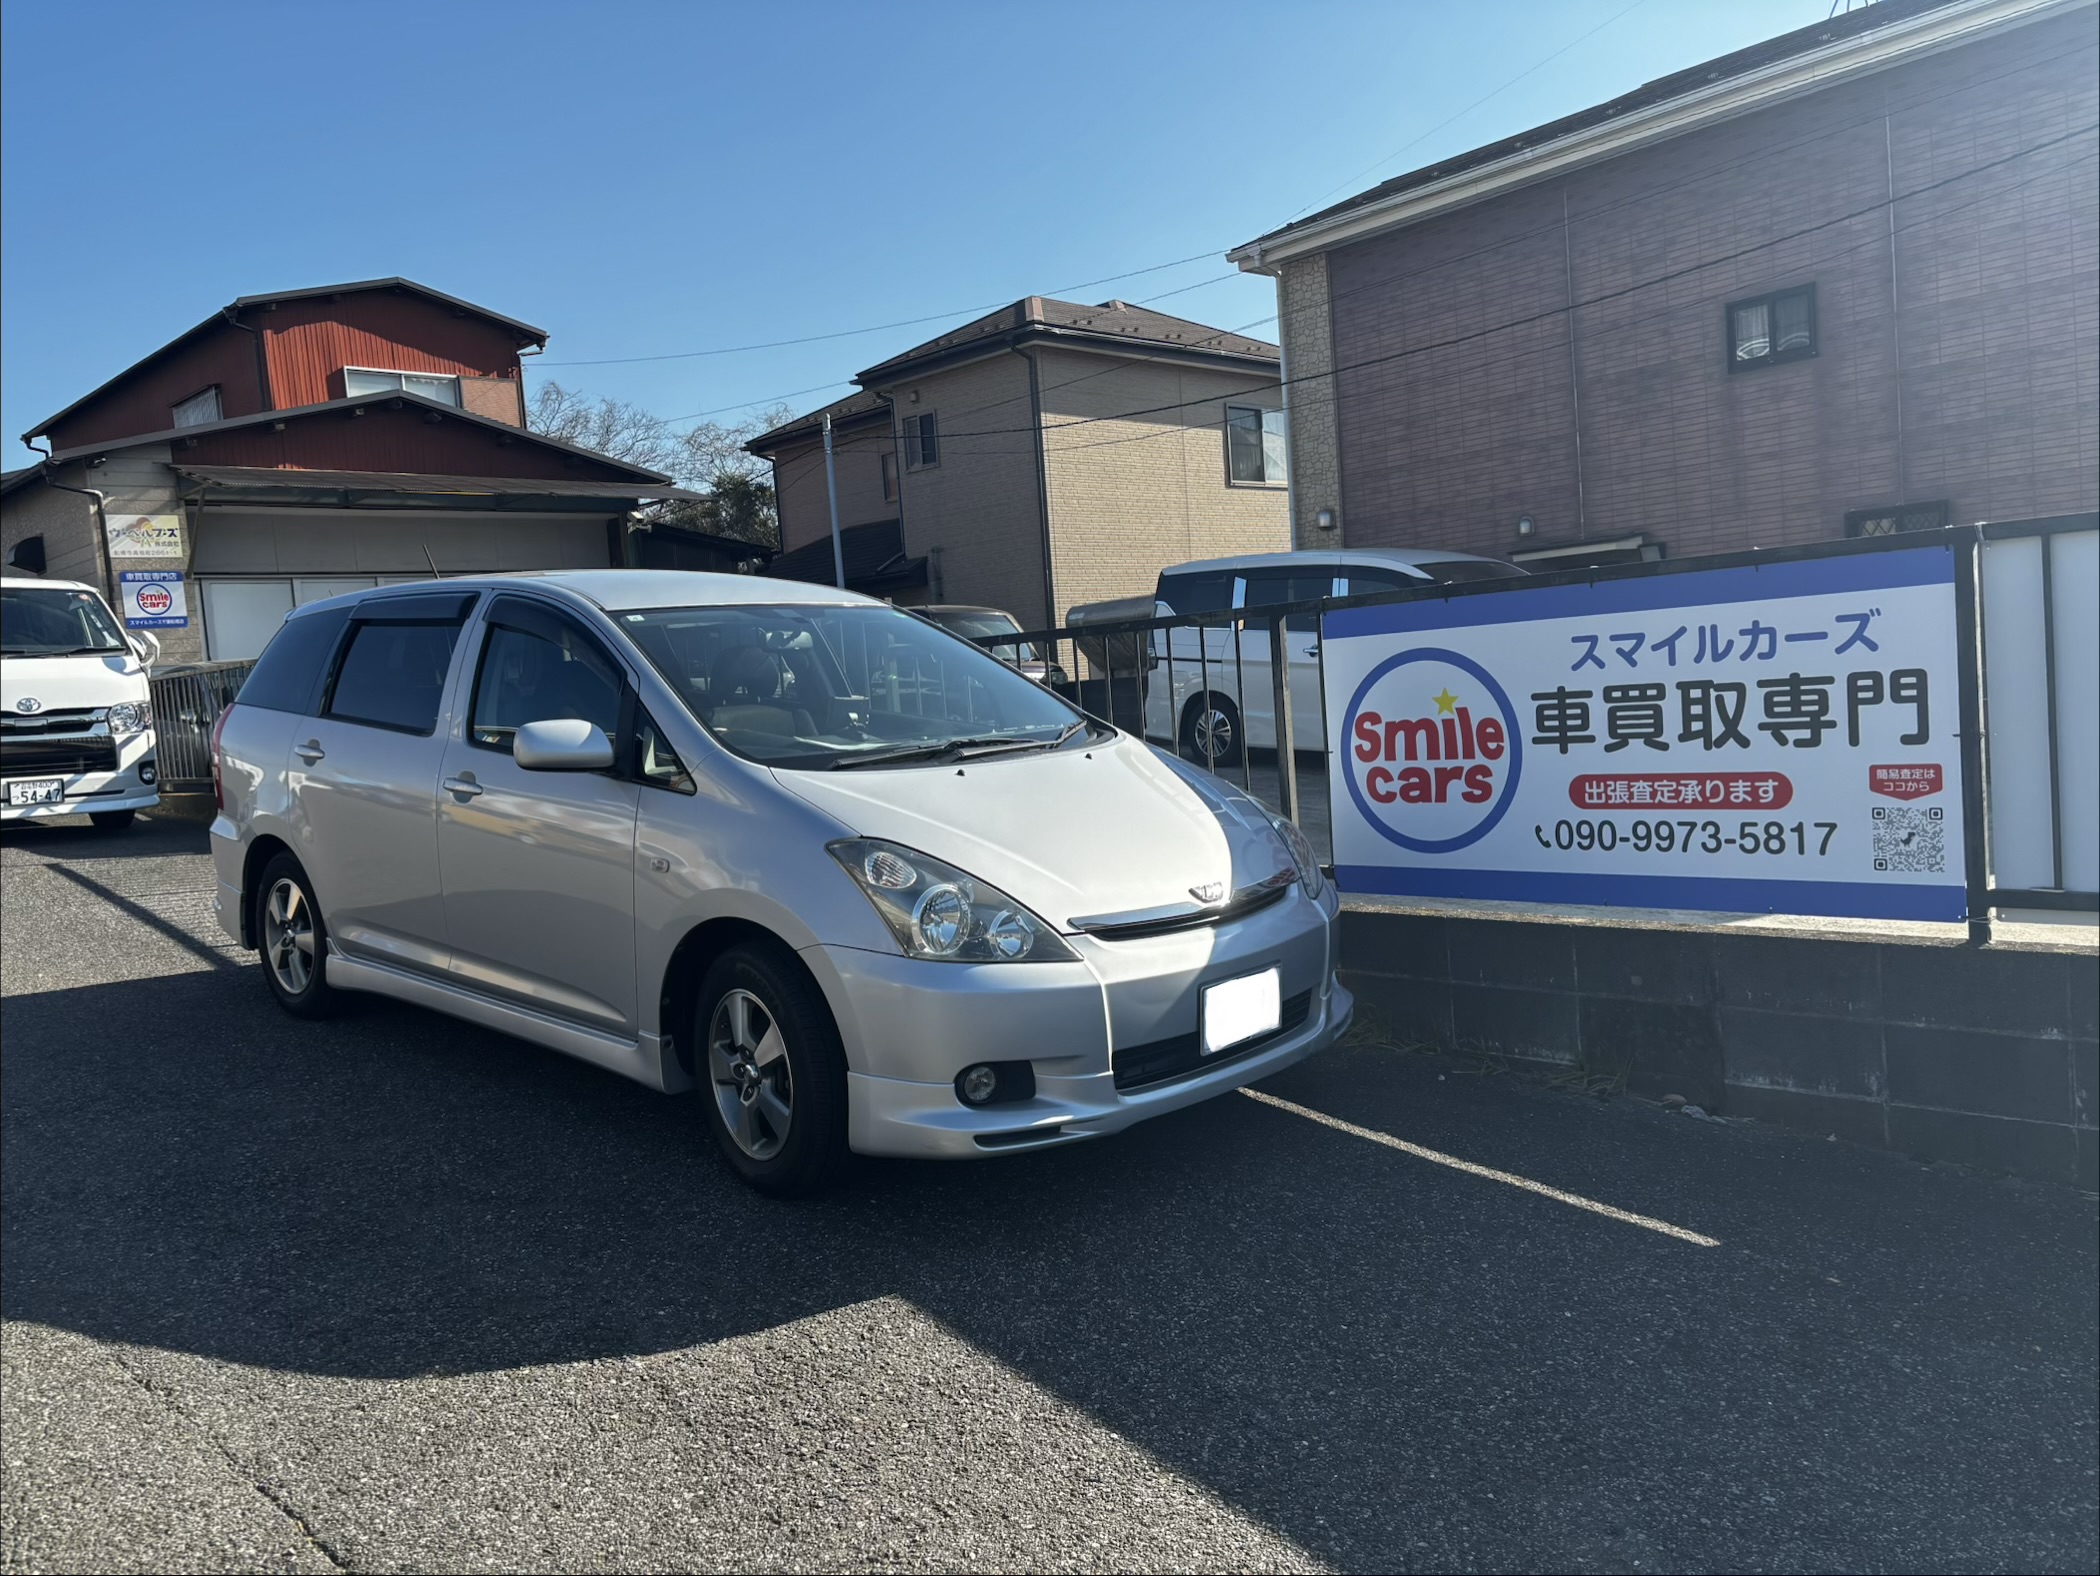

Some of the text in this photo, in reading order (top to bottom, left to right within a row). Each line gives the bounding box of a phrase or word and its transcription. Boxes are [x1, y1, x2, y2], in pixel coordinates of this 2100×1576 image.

[125, 572, 177, 581] 車買取専門店
[139, 592, 169, 602] Smile
[142, 601, 168, 609] cars
[1570, 607, 1882, 671] スマイルカーズ
[1530, 668, 1931, 755] 車買取専門
[1354, 706, 1505, 763] Smile
[1366, 764, 1493, 804] cars
[1876, 768, 1936, 780] 簡易査定は
[20, 788, 61, 803] 54-47
[1583, 778, 1779, 804] 出張査定承ります
[1883, 781, 1930, 792] ココから
[1554, 819, 1838, 856] 090-9973-5817
